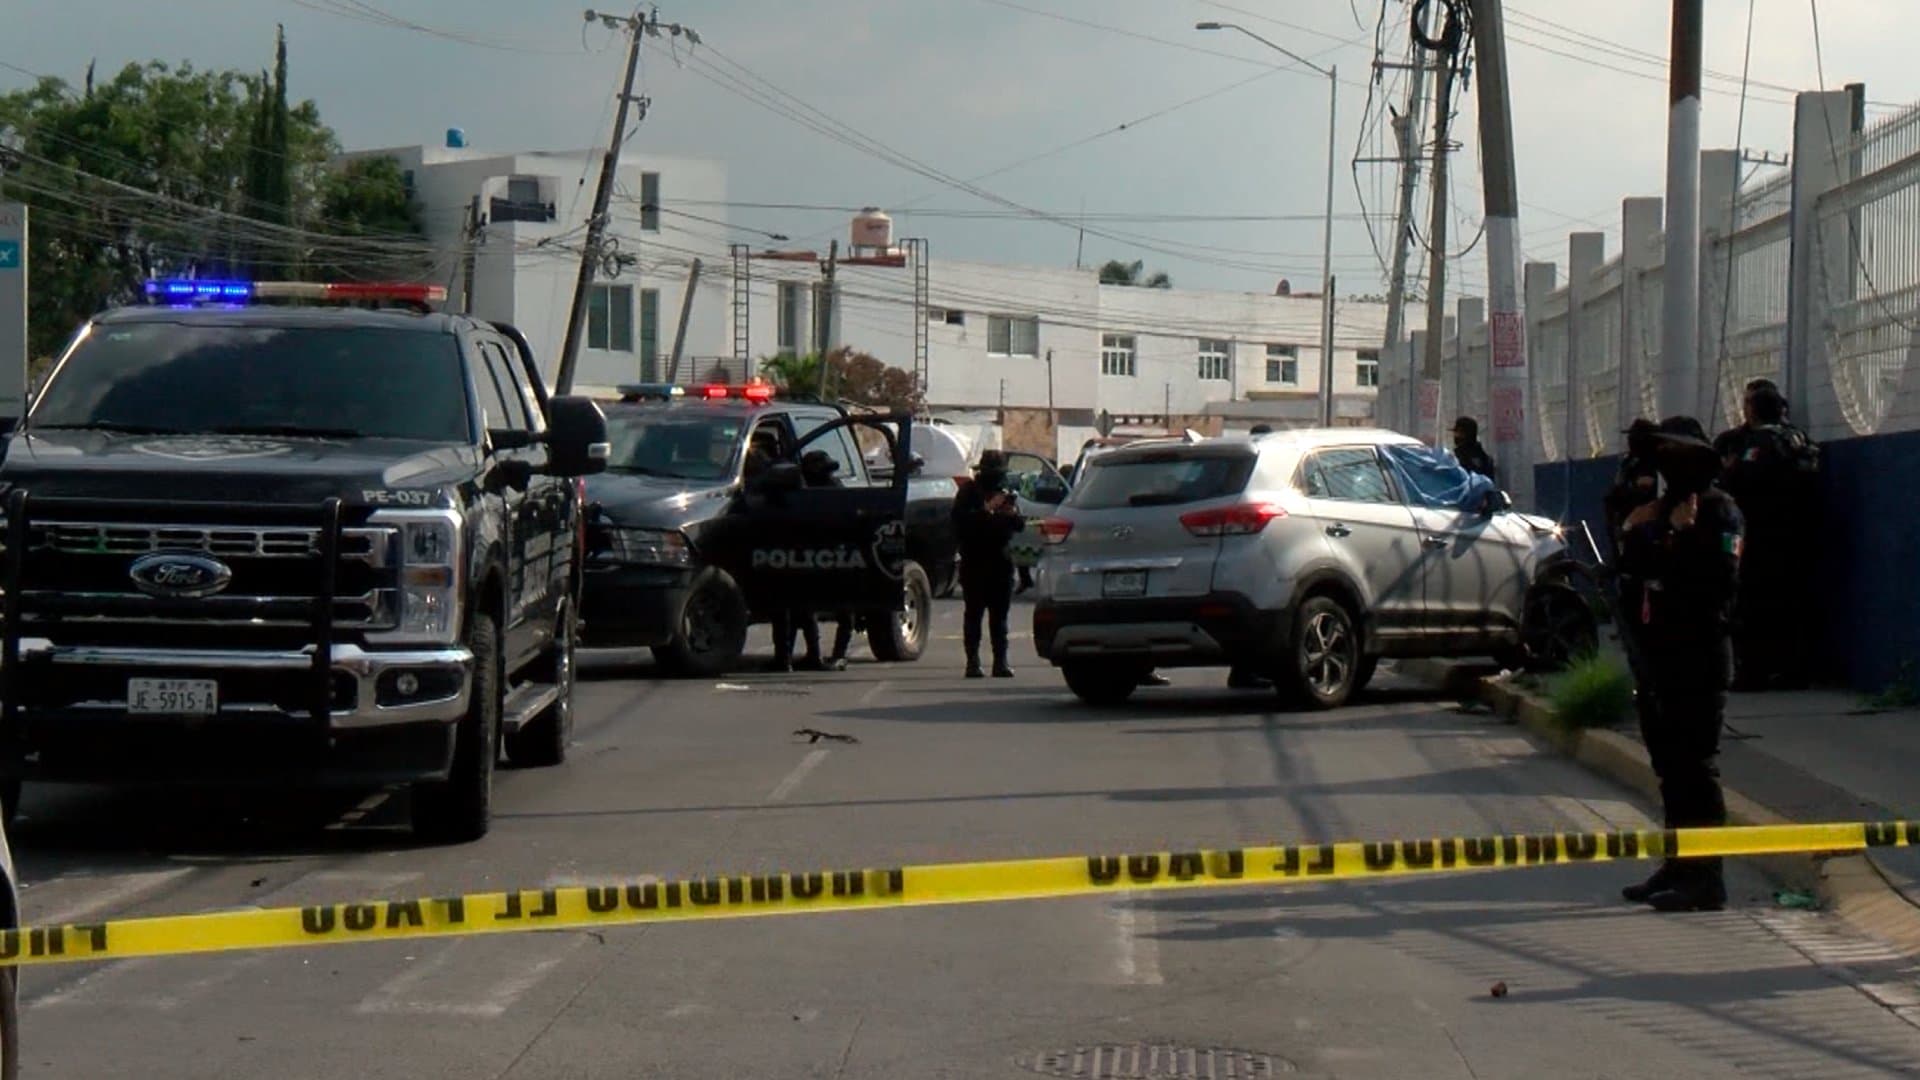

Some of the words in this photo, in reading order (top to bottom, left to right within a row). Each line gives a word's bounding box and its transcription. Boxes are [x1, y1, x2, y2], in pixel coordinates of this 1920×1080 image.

[362, 489, 431, 505] PE-037
[752, 544, 867, 568] POLICÍA
[154, 564, 203, 584] Ford
